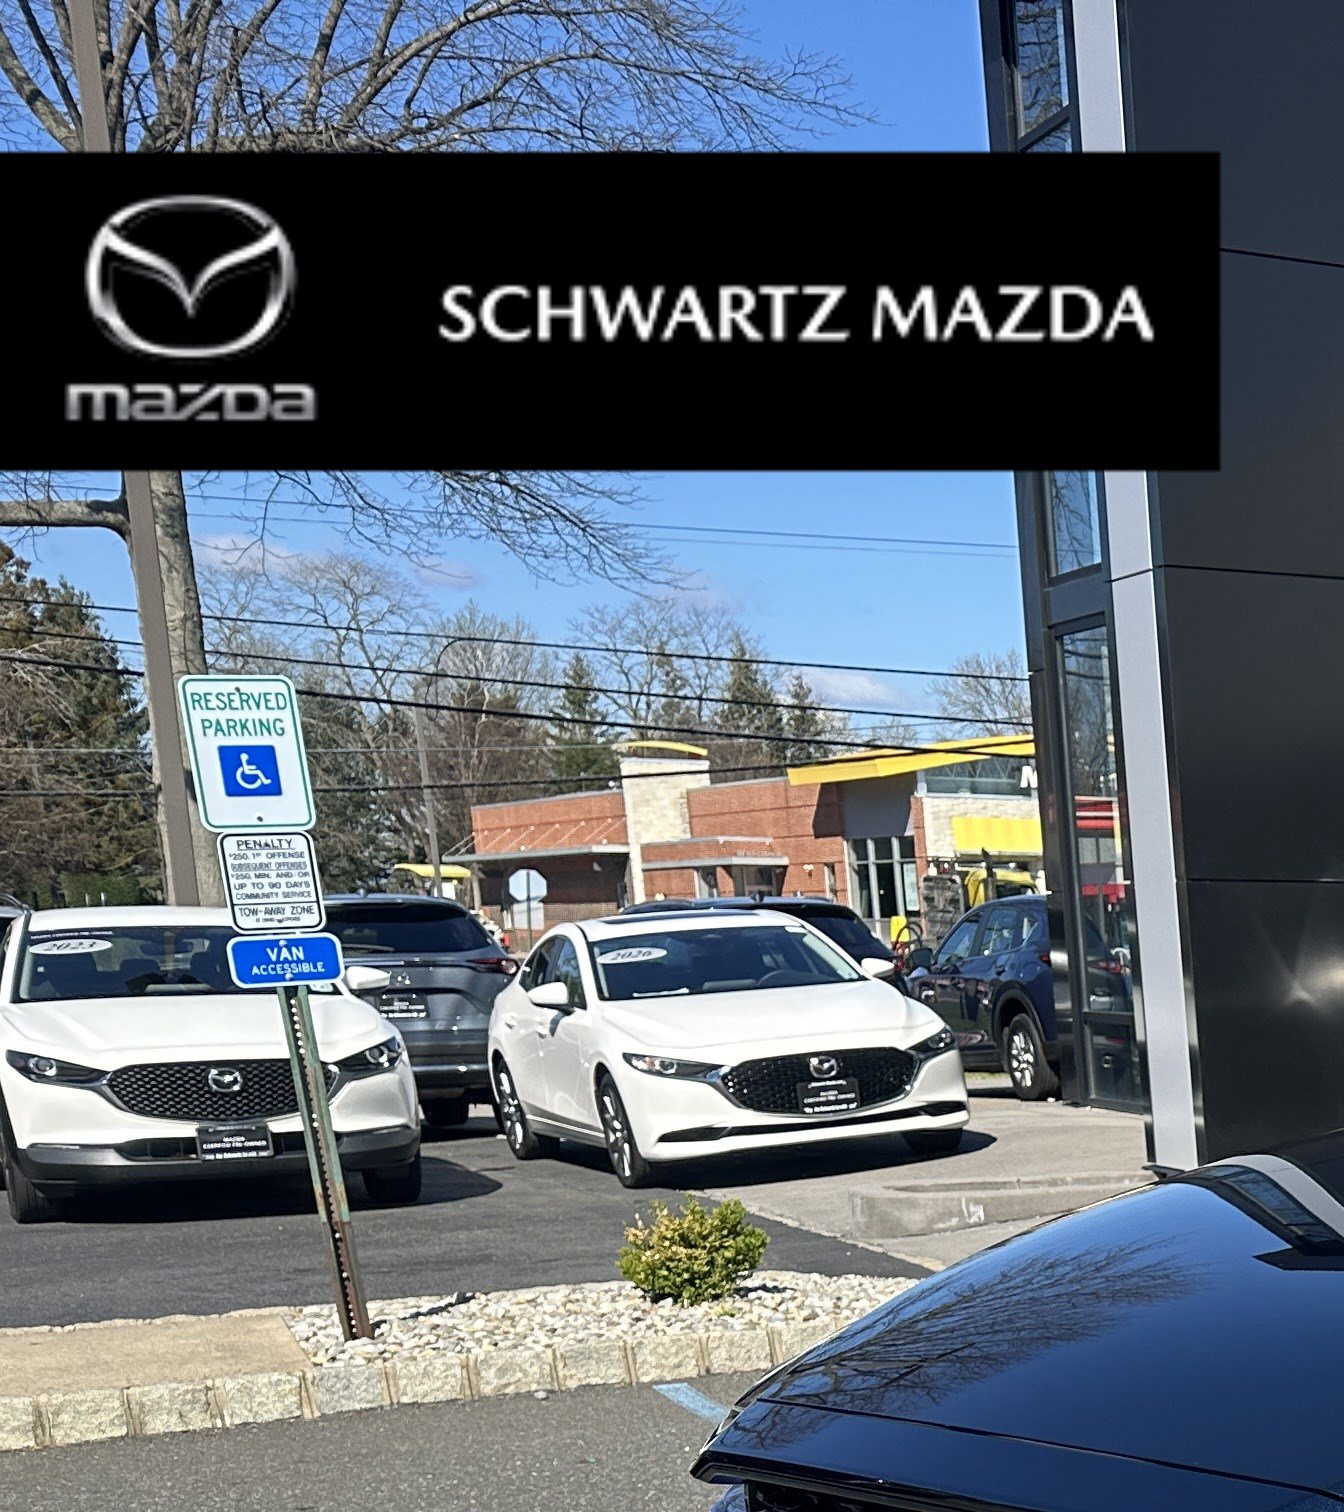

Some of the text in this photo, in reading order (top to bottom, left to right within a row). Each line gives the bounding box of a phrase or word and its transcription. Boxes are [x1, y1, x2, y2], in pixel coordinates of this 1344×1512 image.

[190, 692, 287, 711] RESERVED
[201, 718, 285, 738] PARKING
[236, 838, 293, 850] PENALTY
[265, 851, 305, 859] OFFENSE
[274, 861, 307, 870] OFFENSES
[233, 880, 311, 890] UP TO 90 DAYS
[235, 890, 312, 901] COMMUNITY SERVICE
[238, 905, 316, 917] TOW-AWAY ZONE
[265, 945, 305, 962] VAN
[251, 961, 326, 976] ACCESSIBLE
